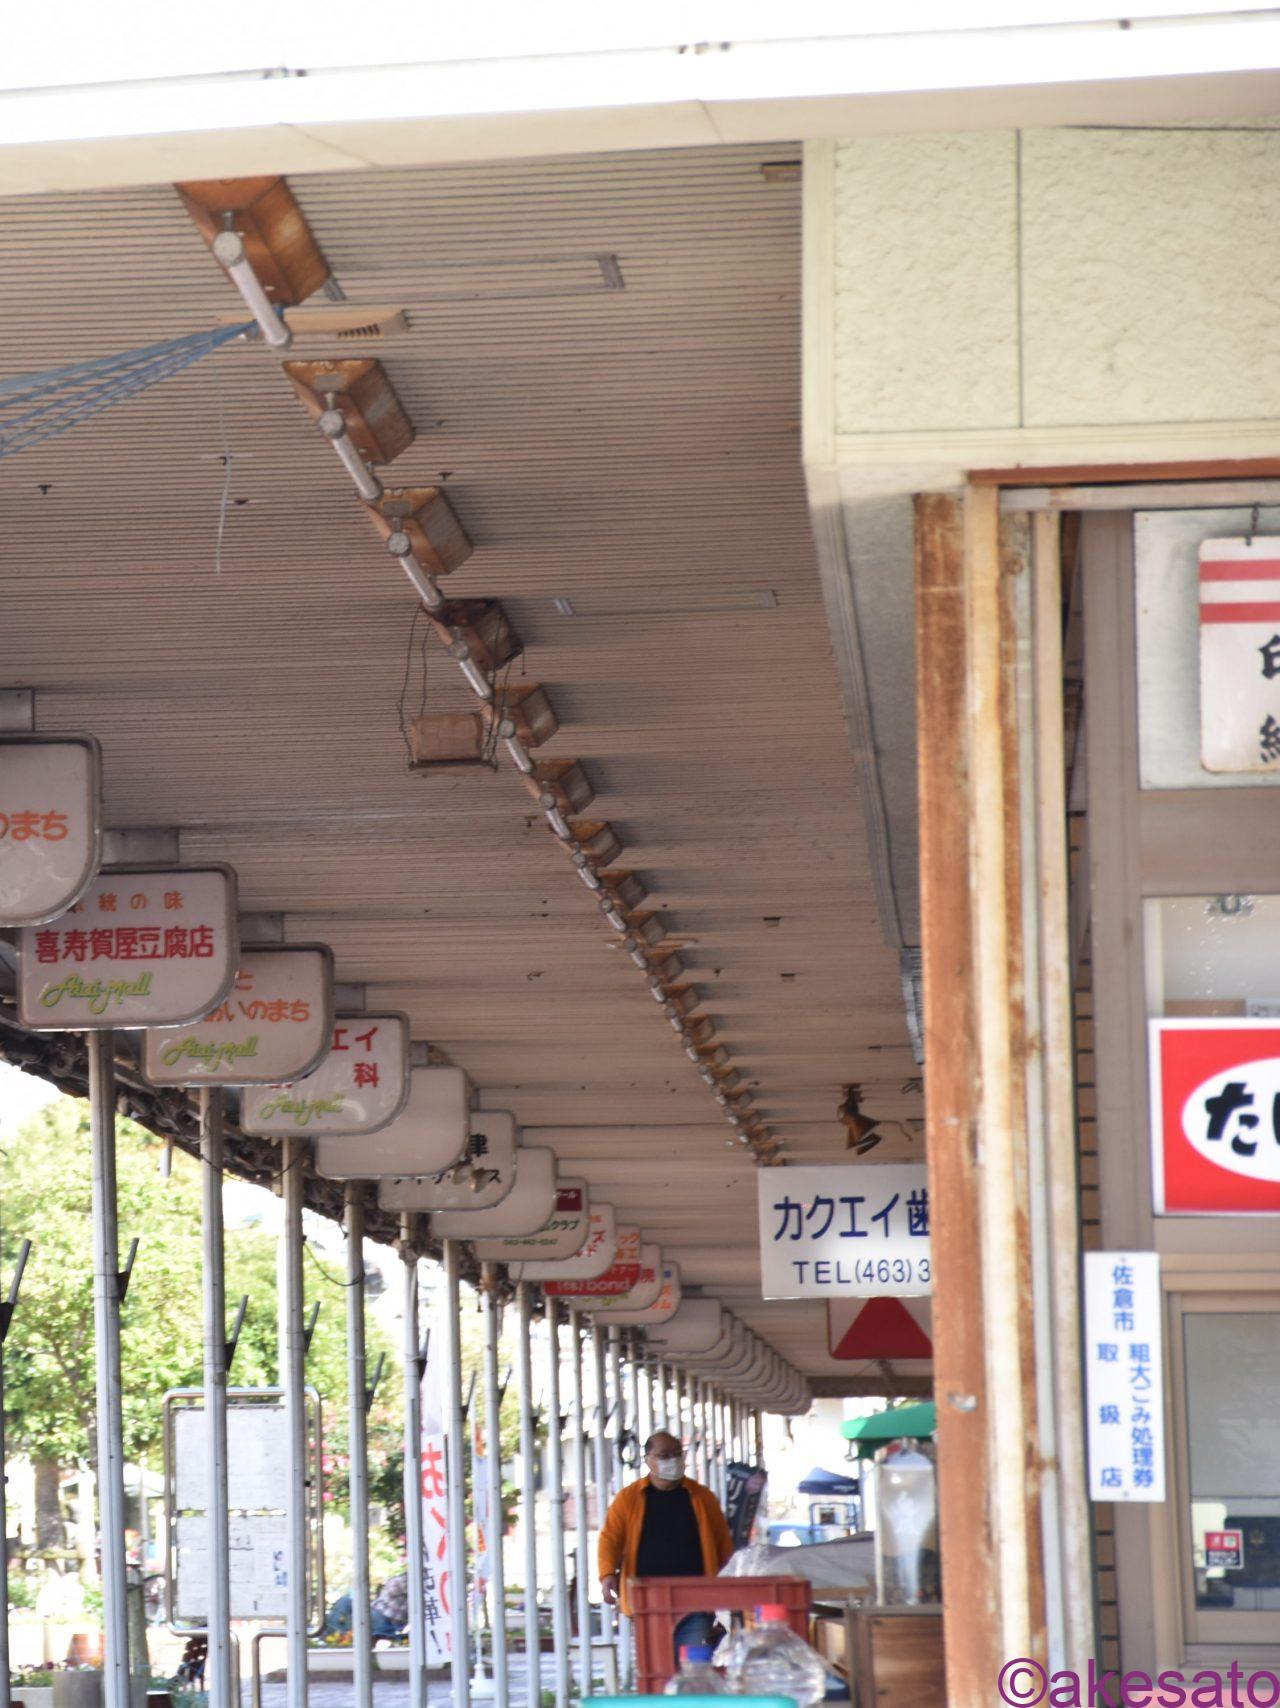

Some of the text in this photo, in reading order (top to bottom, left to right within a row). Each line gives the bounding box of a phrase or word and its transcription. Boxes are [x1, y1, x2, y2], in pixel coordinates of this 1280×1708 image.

[35, 924, 215, 964] 喜寿賀屋豆腐店
[1204, 1081, 1280, 1157] た
[1111, 1264, 1134, 1332] 佐倉市
[1096, 1342, 1123, 1489] 取扱店
